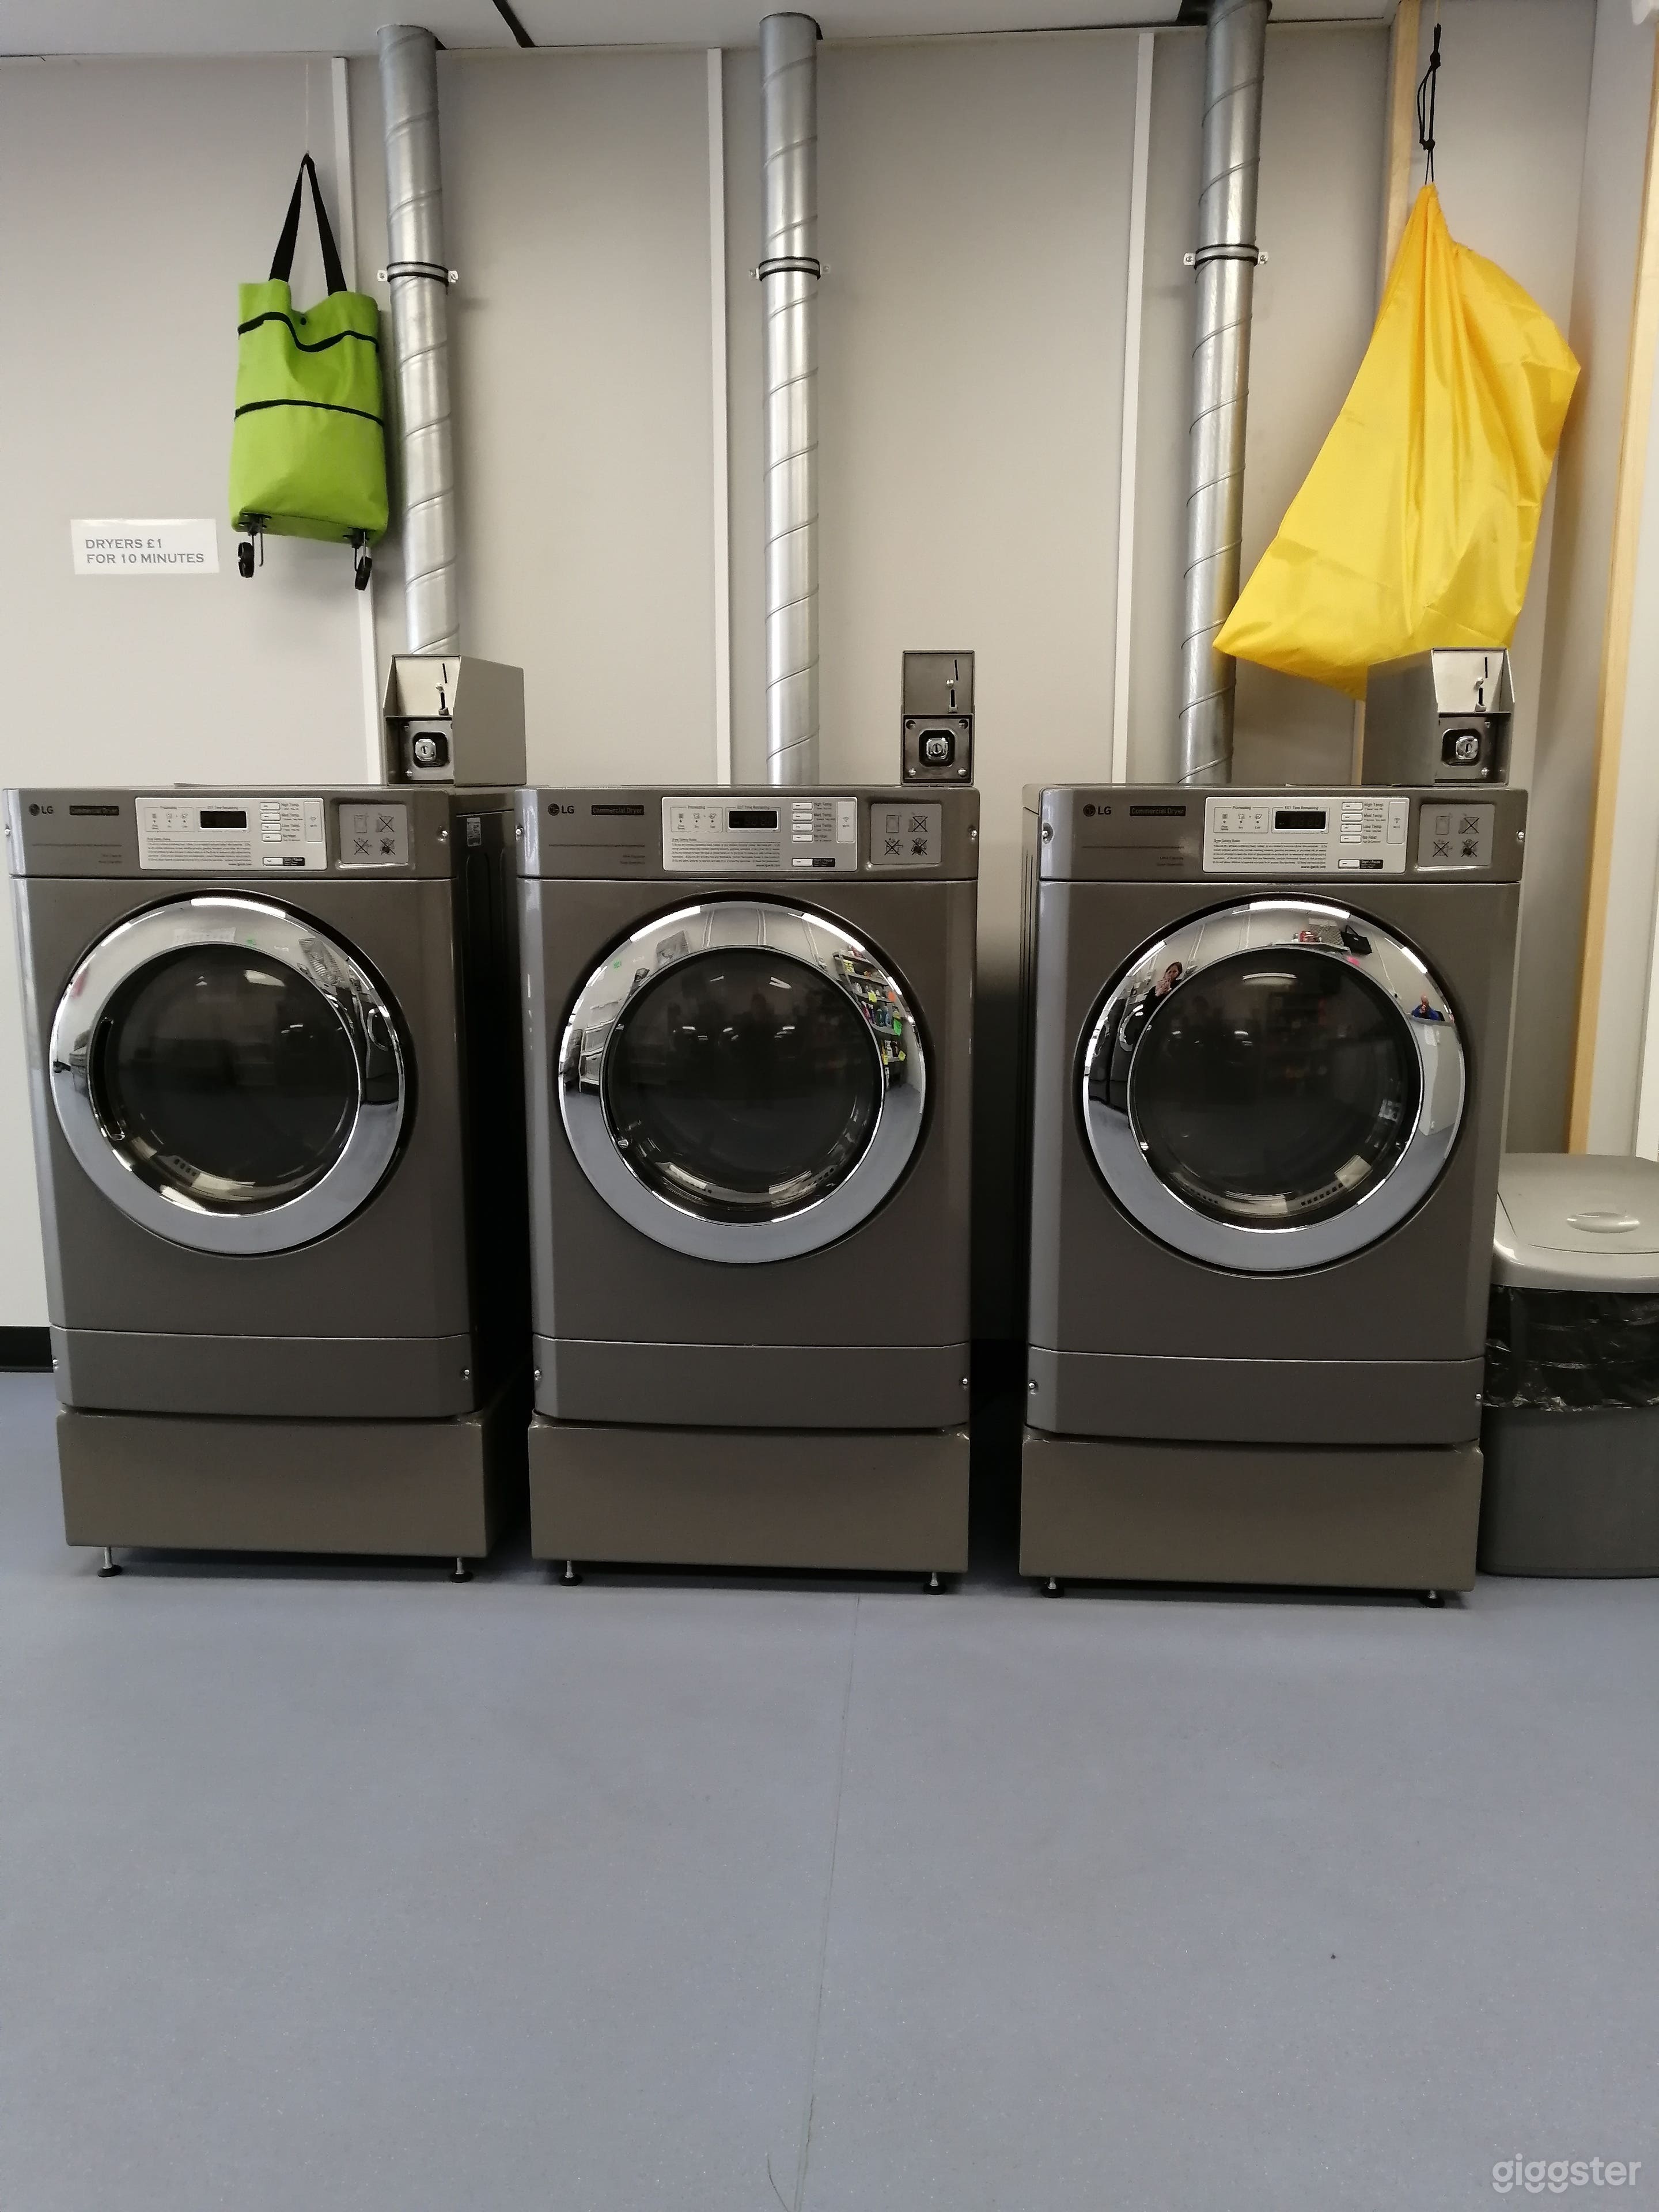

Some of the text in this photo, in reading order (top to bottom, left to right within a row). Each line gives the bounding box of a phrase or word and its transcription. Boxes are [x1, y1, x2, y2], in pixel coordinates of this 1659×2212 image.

[85, 539, 162, 549] DRYERS £1
[87, 553, 204, 564] FOR 10 MINUTES
[561, 805, 574, 814] LG
[1097, 806, 1112, 815] LG
